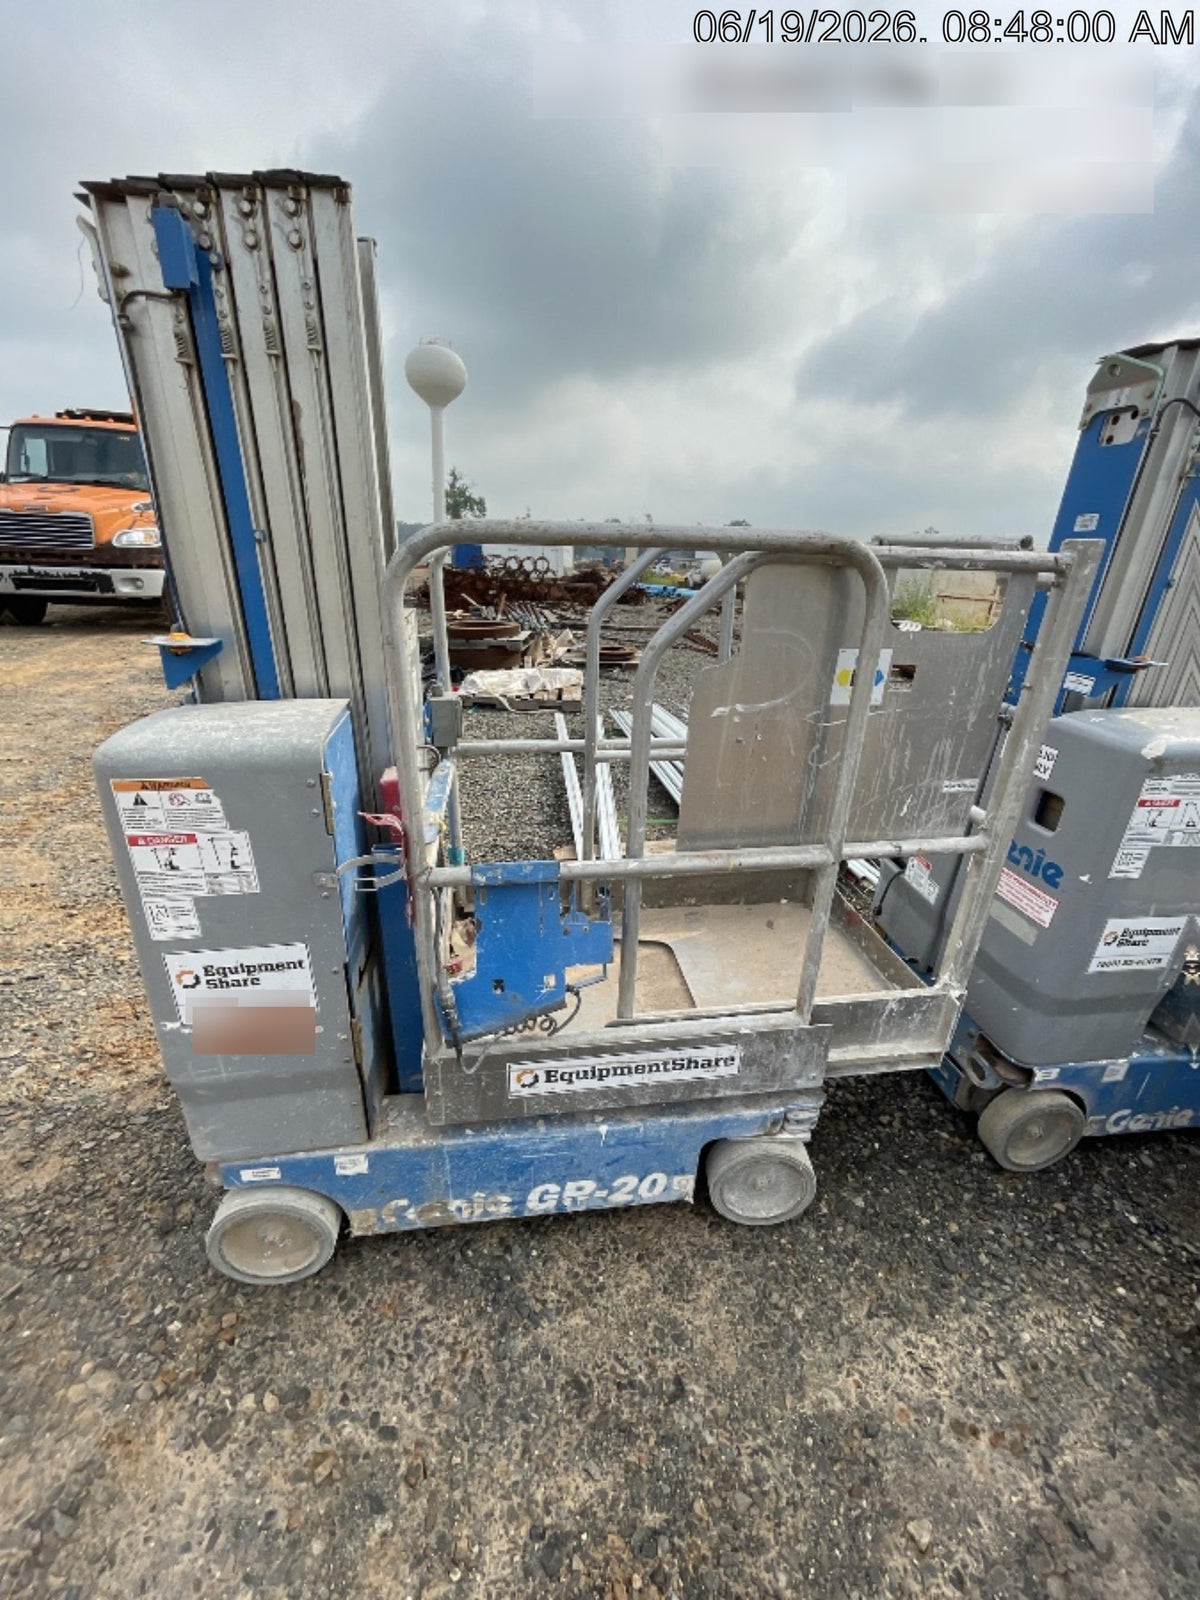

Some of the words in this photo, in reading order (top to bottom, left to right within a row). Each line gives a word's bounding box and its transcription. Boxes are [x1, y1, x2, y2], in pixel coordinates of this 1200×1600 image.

[202, 959, 306, 978] Equipment
[205, 976, 261, 990] Share
[543, 1055, 736, 1085] EquipmentShare
